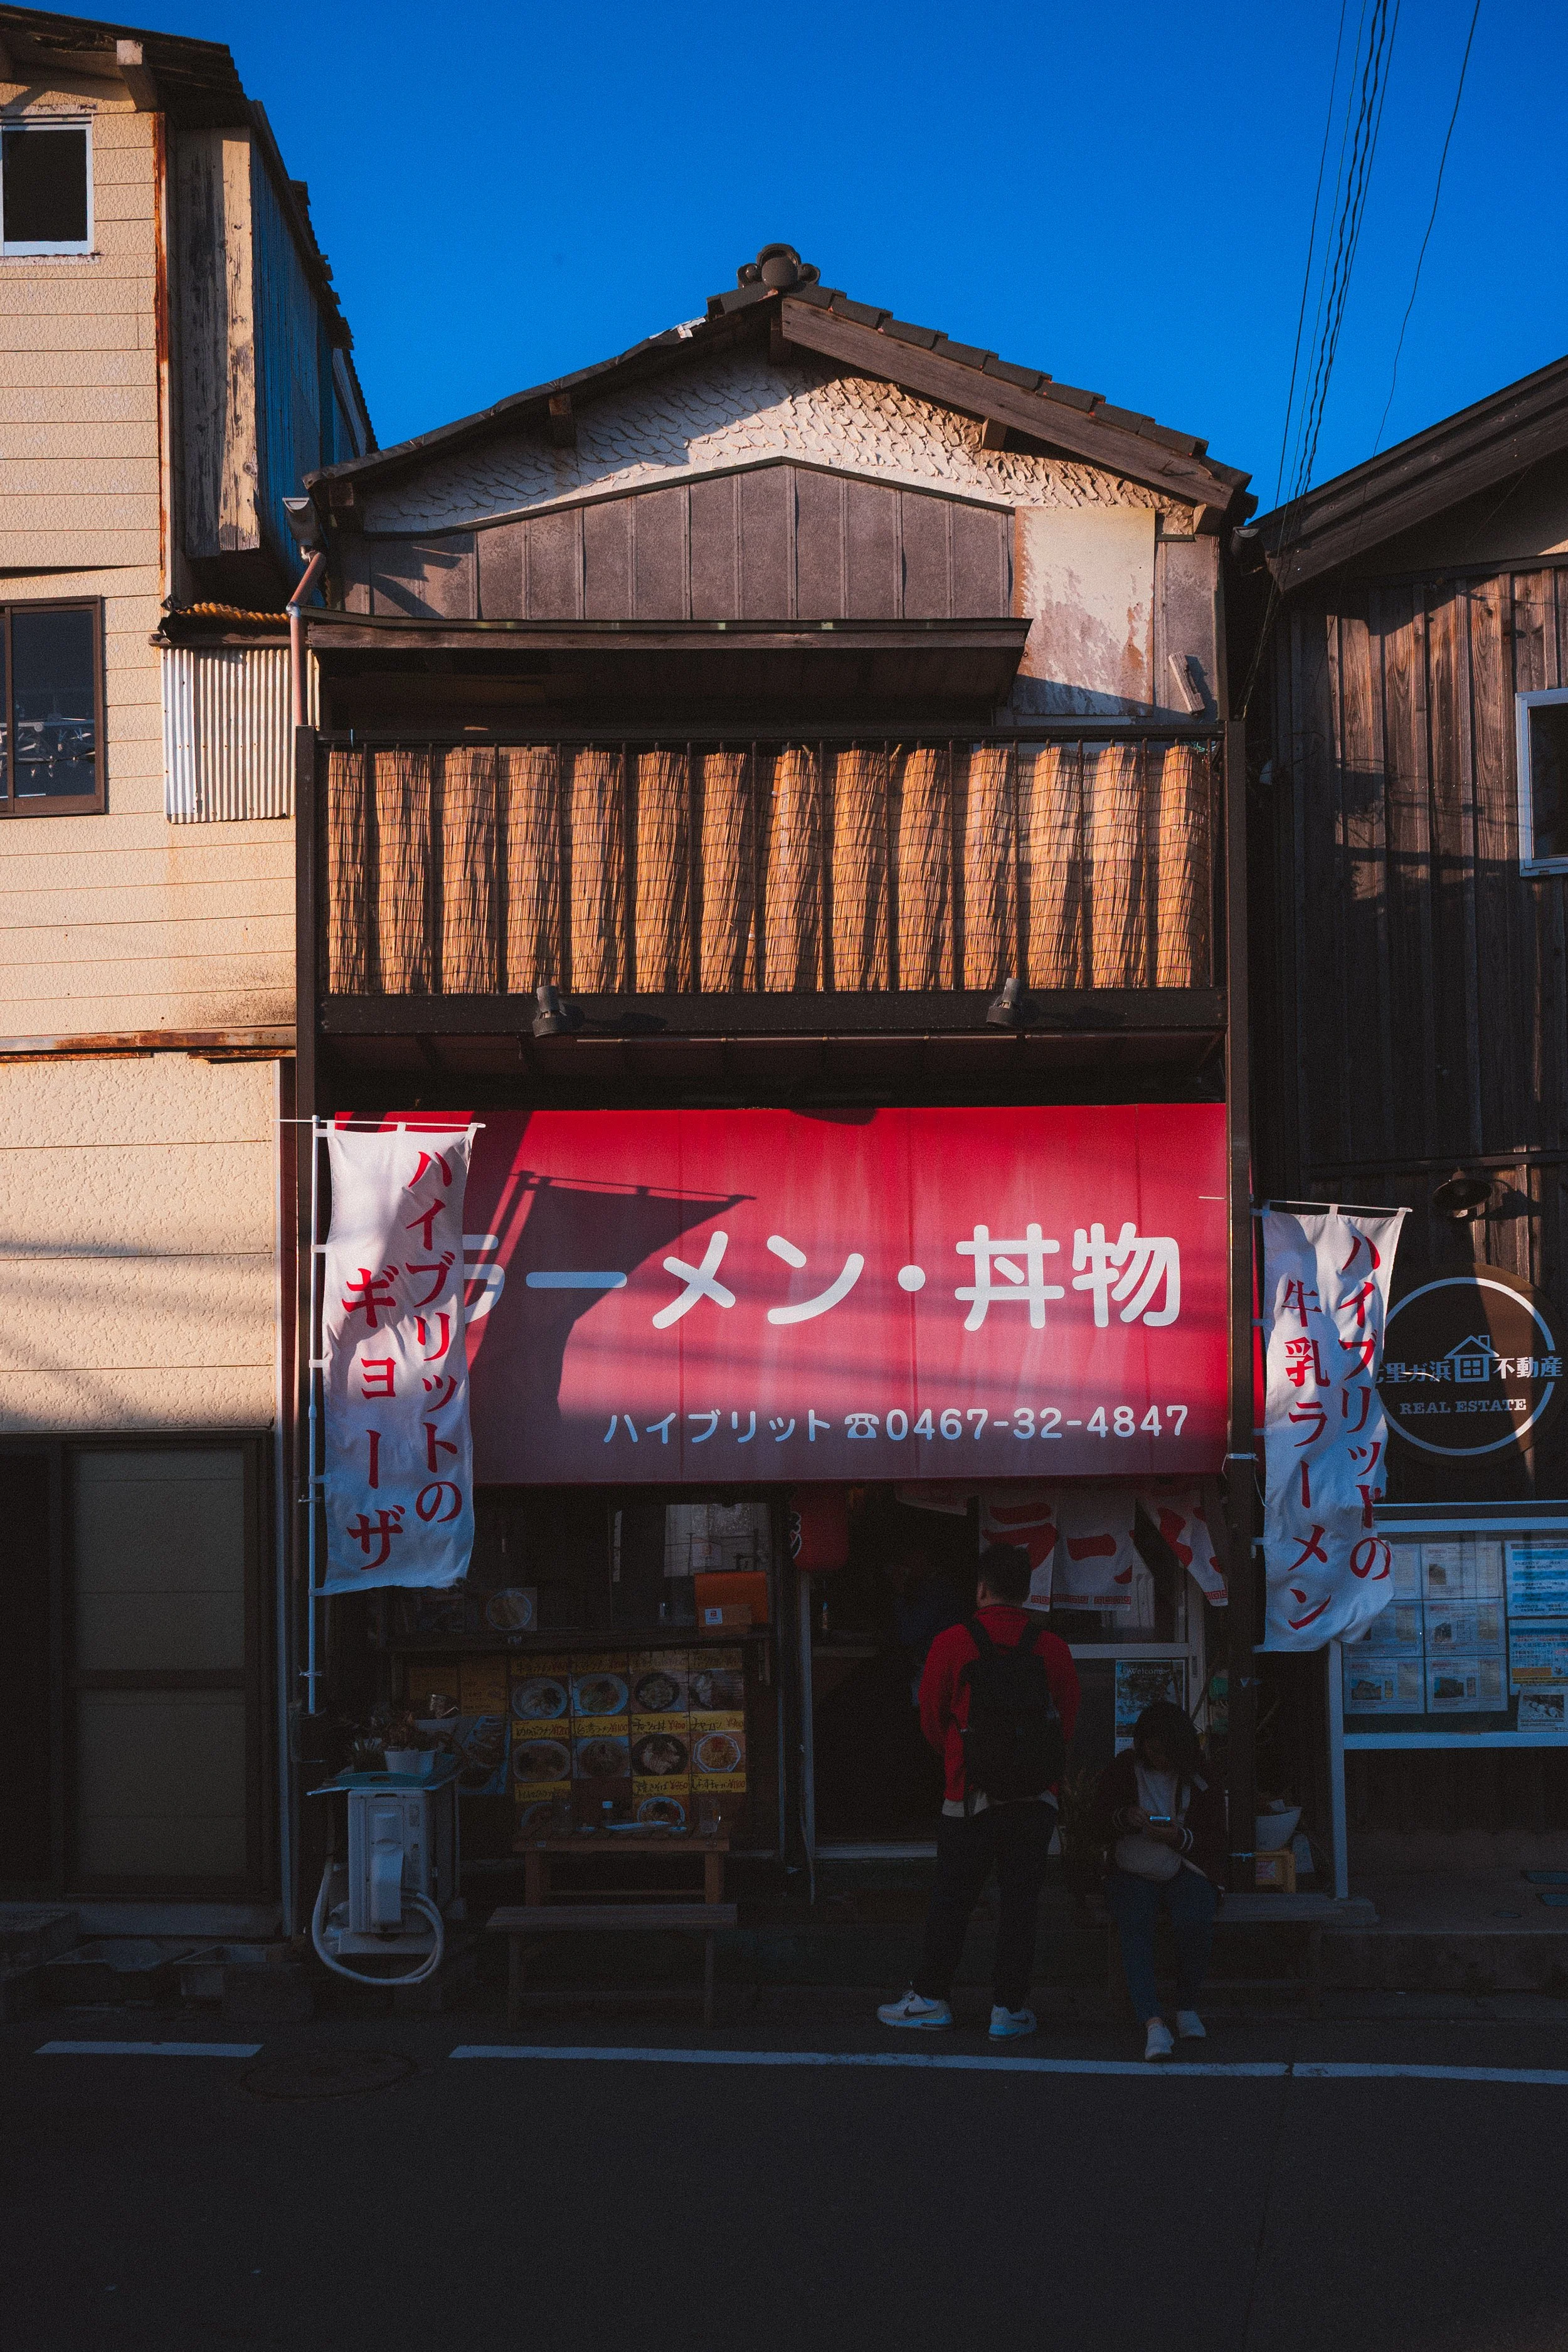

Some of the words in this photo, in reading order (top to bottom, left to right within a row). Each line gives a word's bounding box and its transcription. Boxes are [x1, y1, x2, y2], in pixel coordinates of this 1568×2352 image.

[341, 1266, 406, 1571] ギョーザ
[405, 1150, 463, 1523] ハイブリットの
[603, 1408, 831, 1444] ハイブリット
[886, 1404, 1189, 1441] 0467-32-4847
[1281, 1279, 1331, 1631] 牛乳ラーメン
[1337, 1235, 1391, 1581] ハイブリットの
[1400, 1401, 1451, 1414] REAL
[1456, 1398, 1527, 1413] ESTATE
[1492, 1356, 1564, 1379] 不動産
